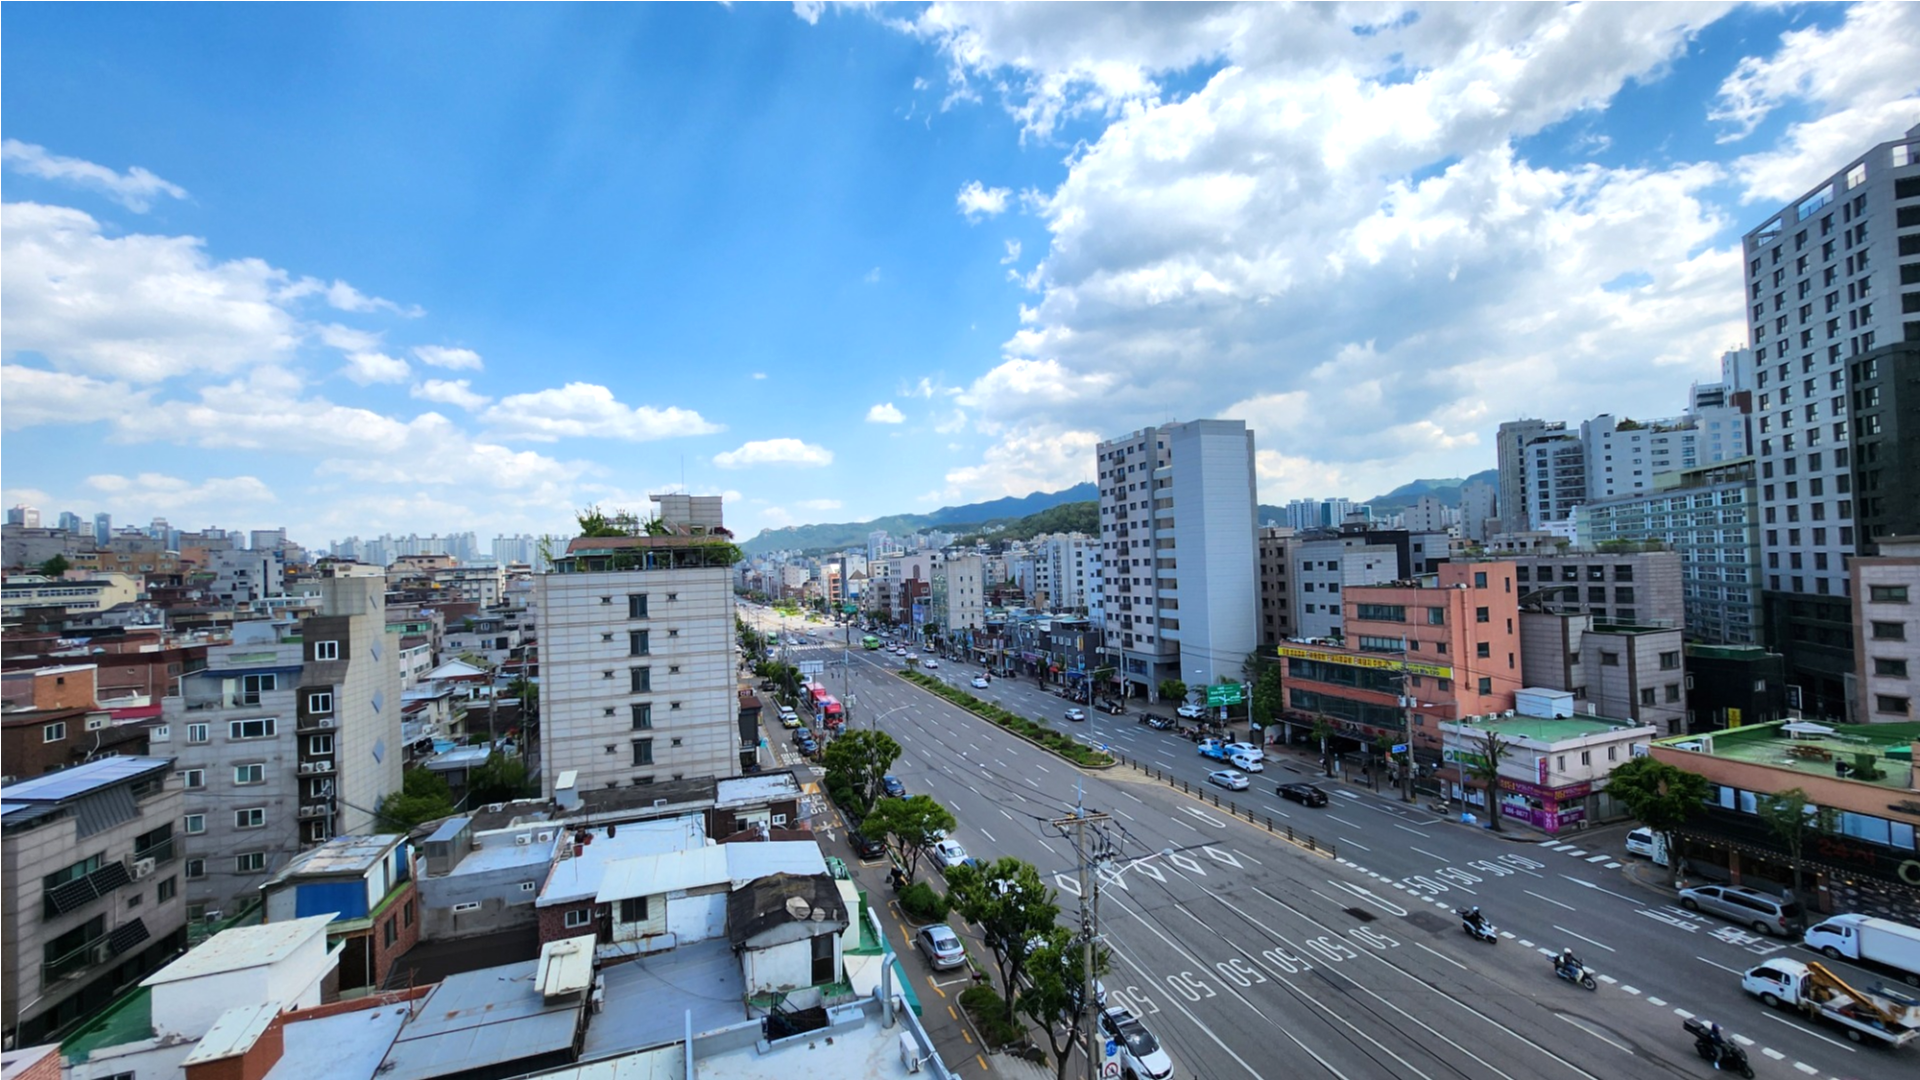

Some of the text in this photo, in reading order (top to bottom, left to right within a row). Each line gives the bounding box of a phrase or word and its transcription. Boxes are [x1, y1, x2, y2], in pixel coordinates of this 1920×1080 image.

[1467, 859, 1515, 877] 50
[1497, 853, 1546, 870] 50
[1402, 875, 1449, 895] 50
[1435, 866, 1483, 885] 50
[1305, 935, 1358, 962] 50
[1348, 925, 1401, 951] 50
[1216, 958, 1267, 988] 50
[1262, 946, 1314, 974] 50
[1166, 971, 1217, 1002] 50
[1111, 985, 1160, 1020] 50
